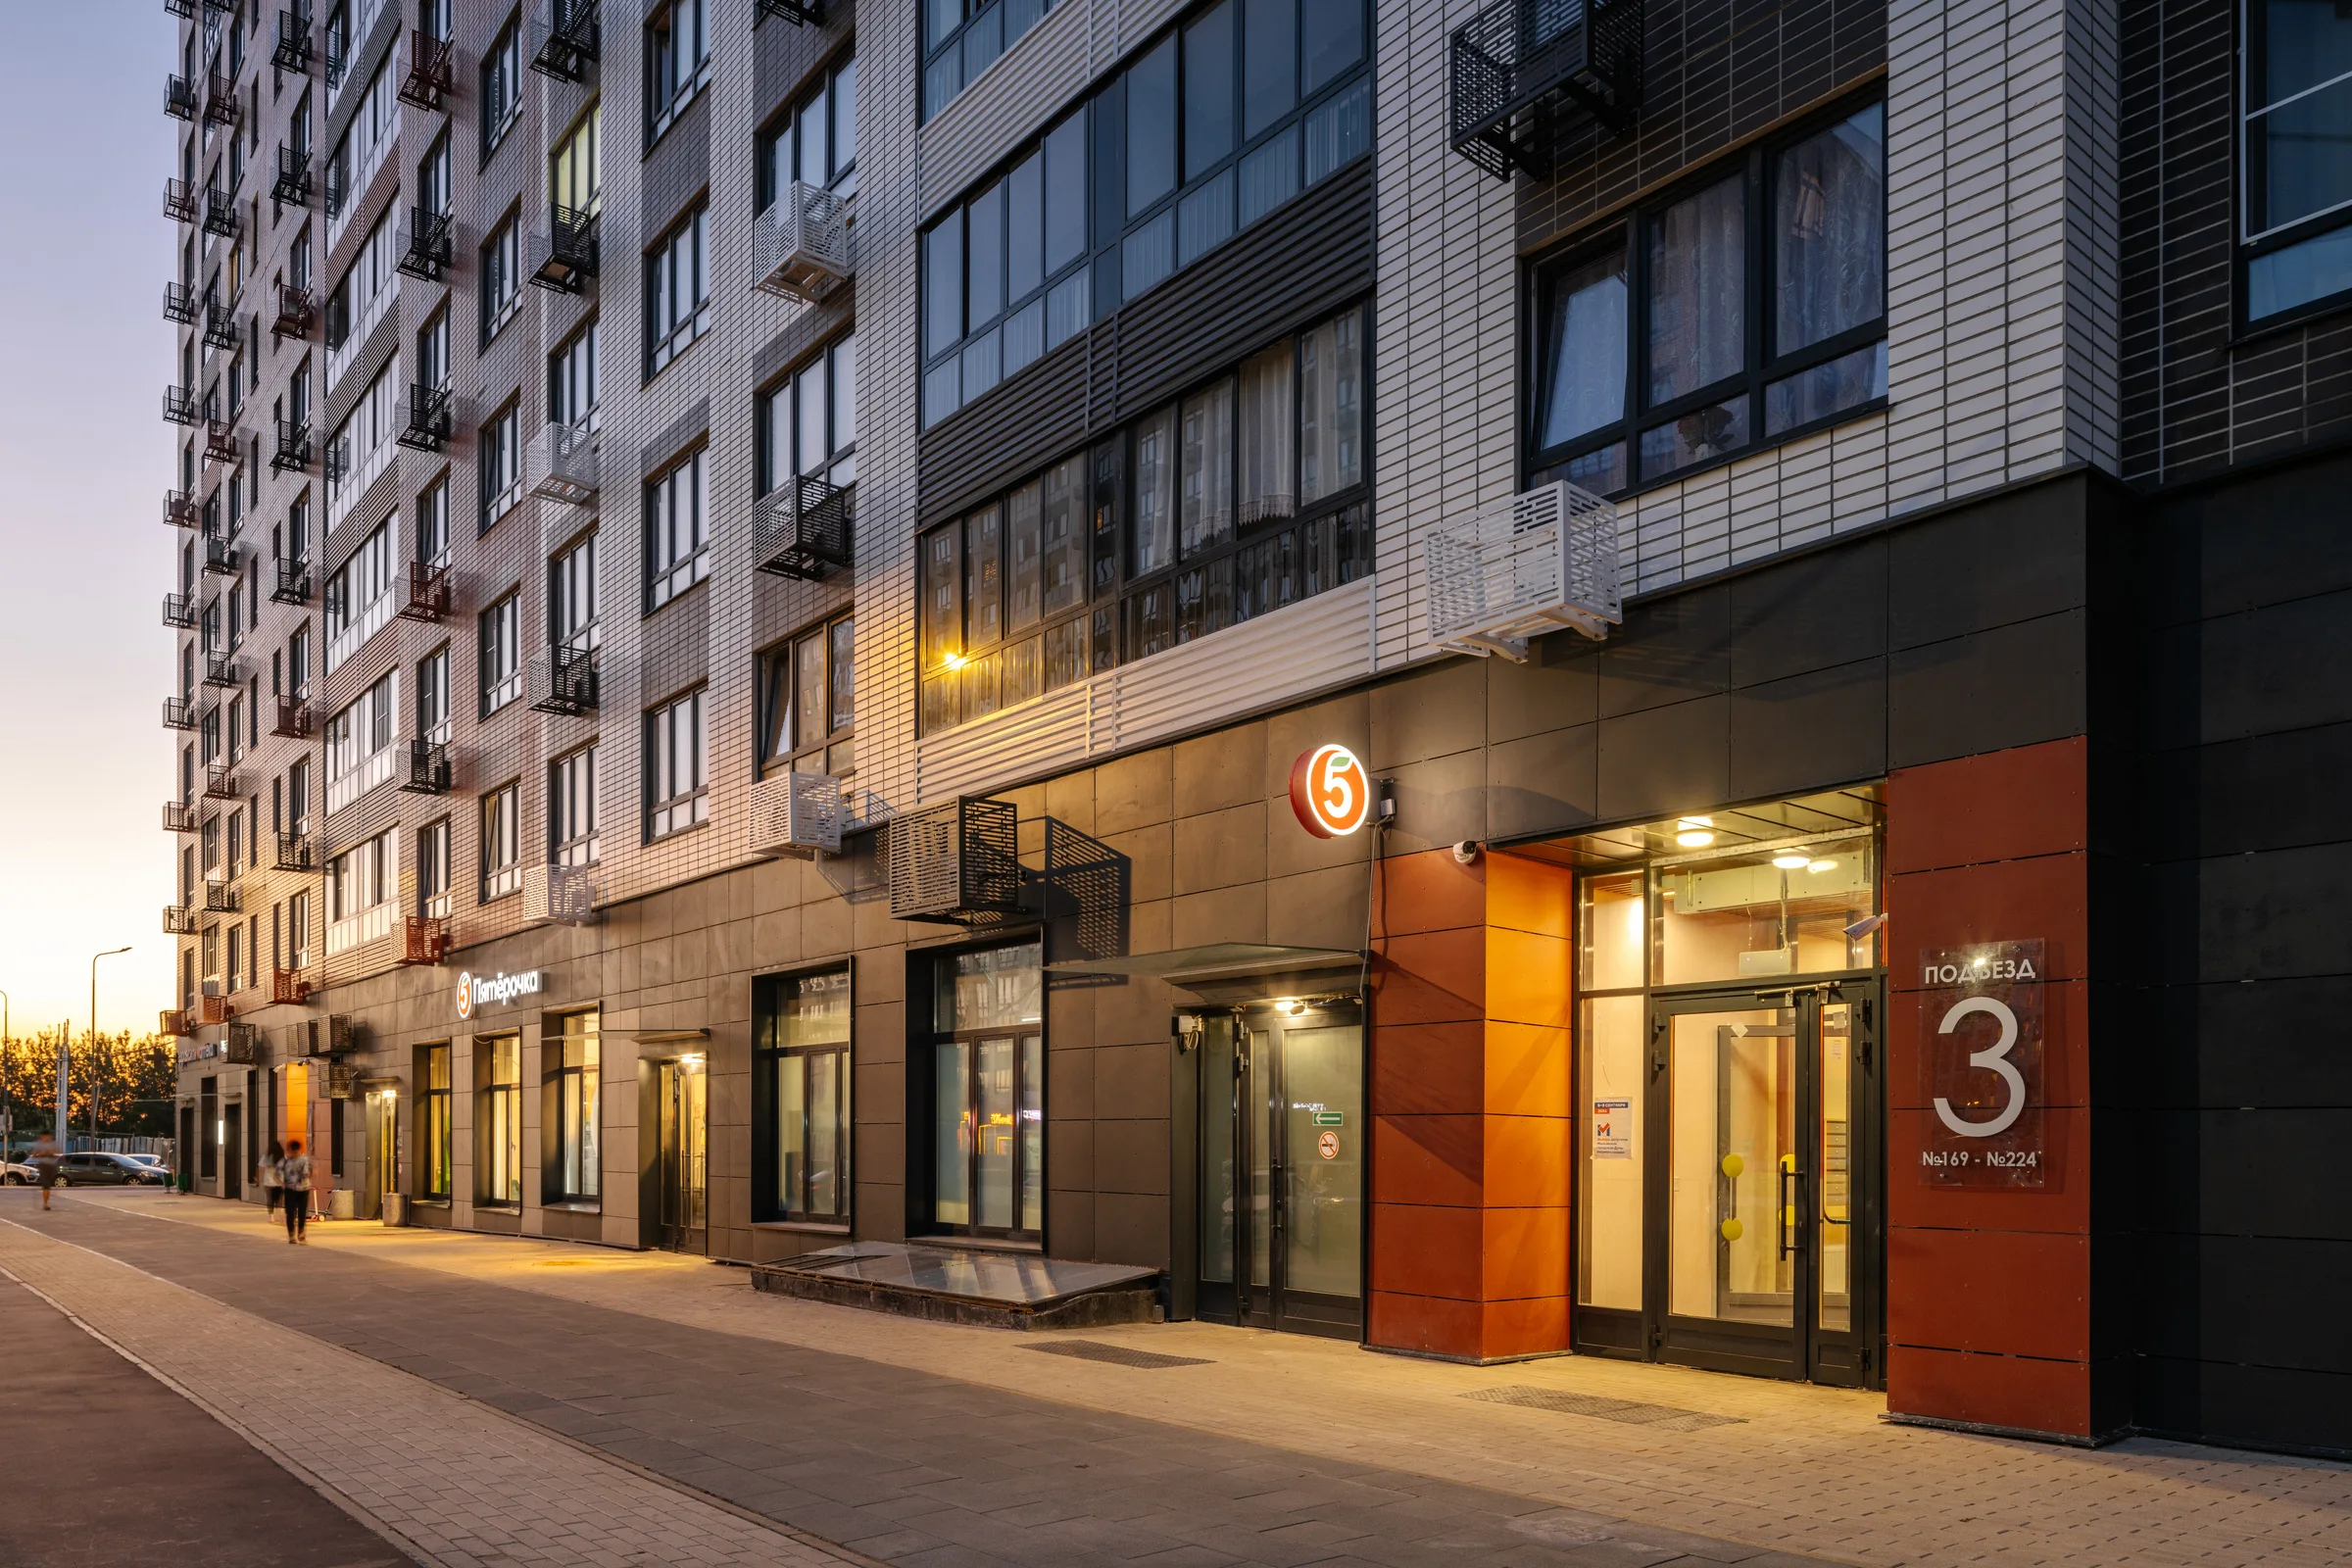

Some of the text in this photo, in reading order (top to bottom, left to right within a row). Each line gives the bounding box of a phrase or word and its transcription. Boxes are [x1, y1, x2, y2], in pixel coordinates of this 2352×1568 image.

[1323, 752, 1353, 818] 5
[460, 970, 538, 1009] 5 Пятёрочка
[1925, 958, 2036, 984] ПОДЪЕЗД
[1933, 996, 2026, 1138] 3
[1922, 1151, 1969, 1166] №169
[1986, 1152, 2037, 1167] №224
